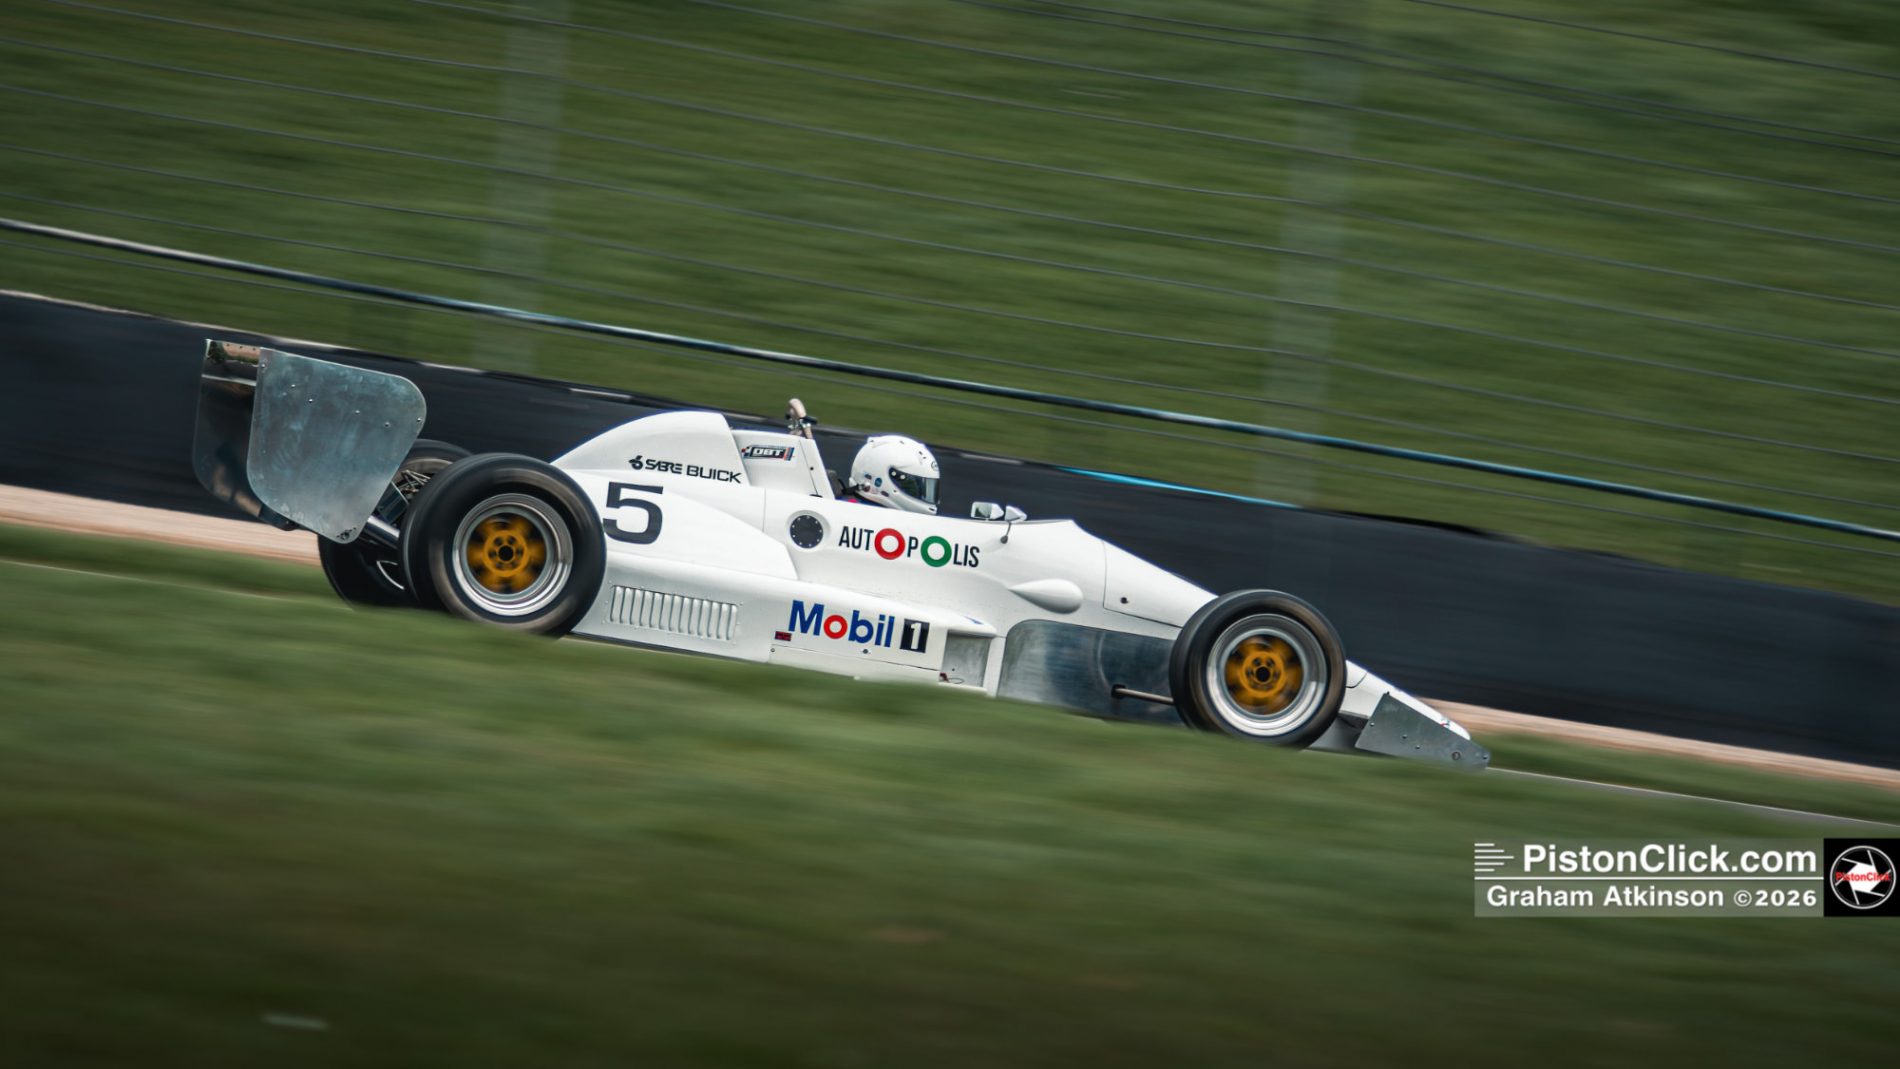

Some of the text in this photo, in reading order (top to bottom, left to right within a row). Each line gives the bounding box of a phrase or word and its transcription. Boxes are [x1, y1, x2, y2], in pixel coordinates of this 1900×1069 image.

[645, 458, 741, 484] SABRE BUICK
[602, 481, 664, 545] 5
[838, 526, 980, 568] AUTOPOLIS
[788, 599, 895, 648] Mobil
